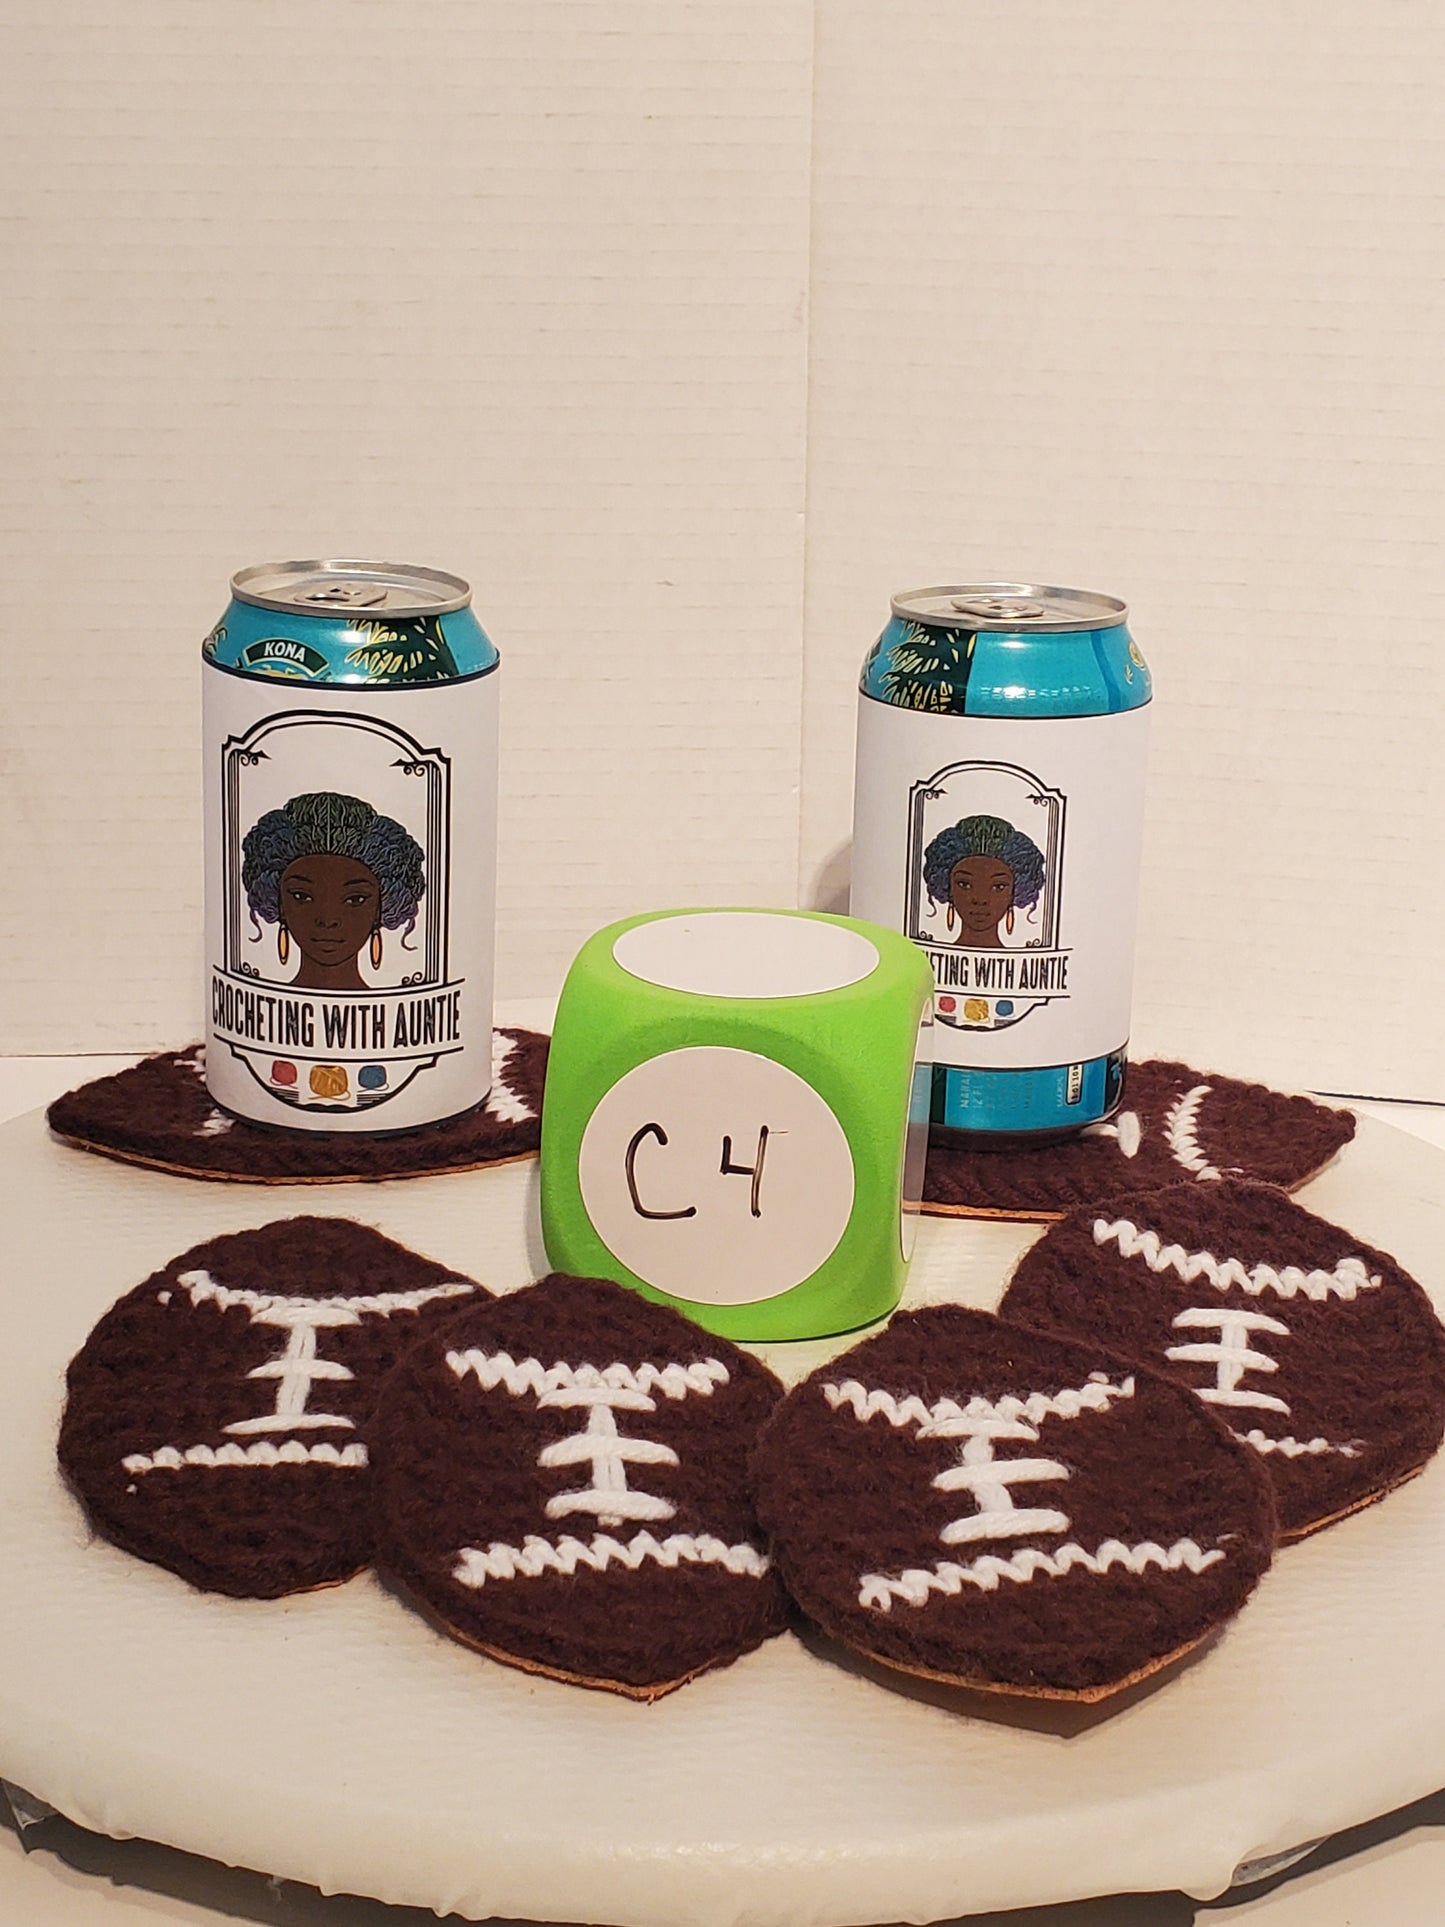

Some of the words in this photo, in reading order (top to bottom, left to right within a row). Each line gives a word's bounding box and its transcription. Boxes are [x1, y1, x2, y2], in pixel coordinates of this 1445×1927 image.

[263, 640, 306, 663] KONA
[974, 956, 1015, 990] WITH
[1019, 955, 1069, 990] AUNTIE
[212, 974, 315, 1048] CROCHETING
[322, 1003, 386, 1050] WITH
[393, 989, 462, 1049] AUNTIE
[625, 1122, 697, 1220] C
[719, 1124, 770, 1218] 4
